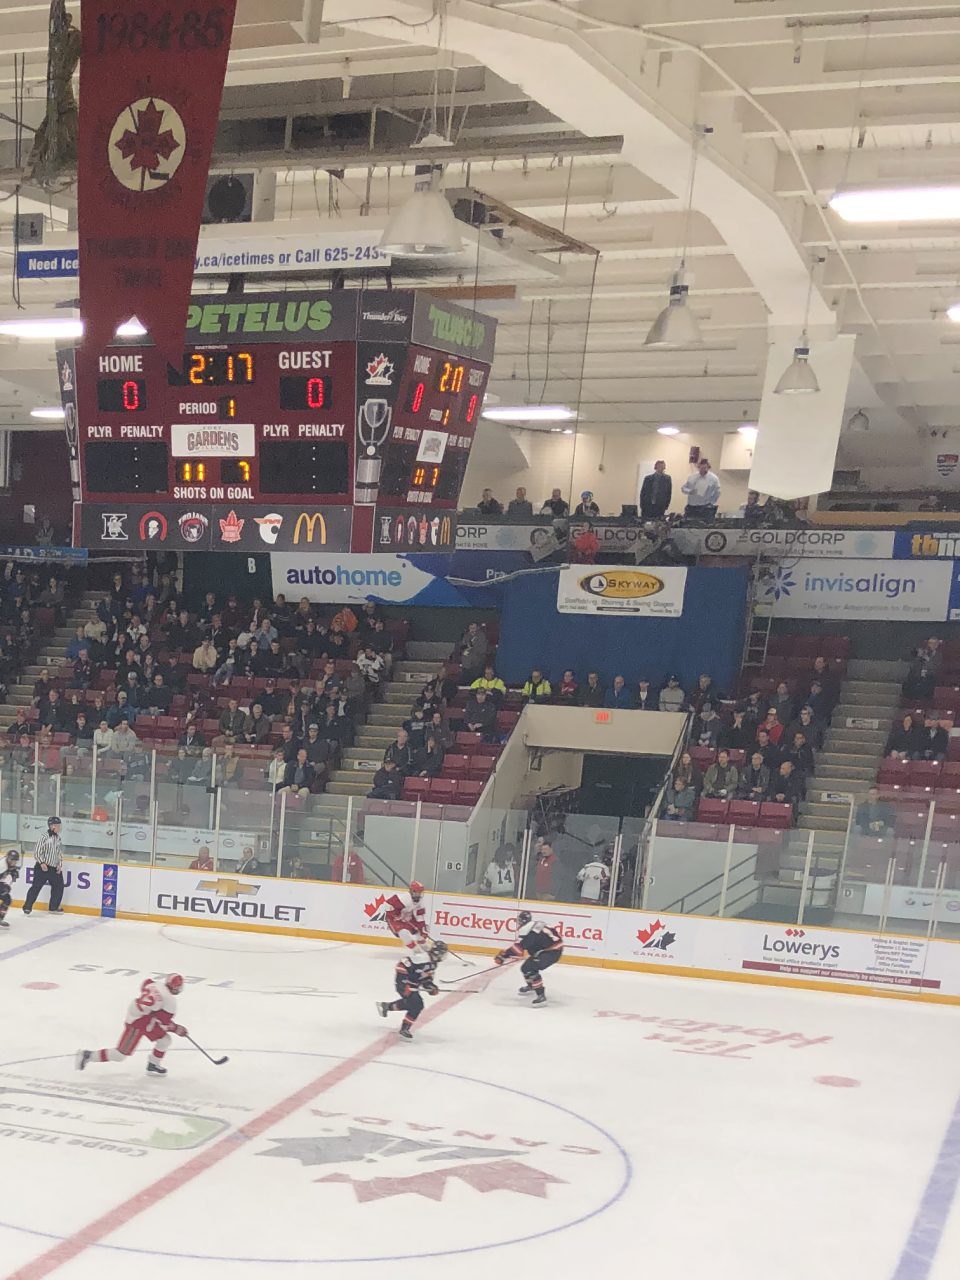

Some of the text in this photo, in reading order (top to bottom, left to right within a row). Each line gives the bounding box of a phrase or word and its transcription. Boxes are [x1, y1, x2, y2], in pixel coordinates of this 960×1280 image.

[28, 257, 57, 271] Need
[278, 252, 291, 264] or
[295, 248, 320, 264] Call
[362, 311, 408, 324] Thunder Bay
[99, 355, 143, 373] HOME
[189, 353, 254, 384] 2:17
[278, 350, 333, 370] GUEST
[122, 380, 139, 410] 0
[306, 377, 324, 408] 0
[178, 402, 217, 415] PERIOD
[227, 399, 236, 417] 1
[87, 425, 164, 438] PLYR PENALTY
[263, 423, 345, 437] PLYR PENALTY
[187, 430, 239, 453] GARDENS
[183, 462, 205, 482] 11
[239, 461, 250, 482] 7
[173, 486, 254, 499] SHOTS ON GOAL
[749, 531, 845, 545] GOLDCORP
[247, 557, 257, 574] B
[286, 564, 402, 586] autohome
[804, 572, 916, 598] invisalign
[496, 869, 513, 885] 14
[157, 893, 306, 923] CHEVROLET
[435, 910, 604, 941] HockeyCda.ca
[633, 950, 675, 959] CANADA
[762, 934, 840, 961] Lowerys
[800, 967, 821, 976] support
[831, 970, 860, 980] community
[593, 1009, 834, 1049] Hortons
[68, 1137, 149, 1158] Coupe
